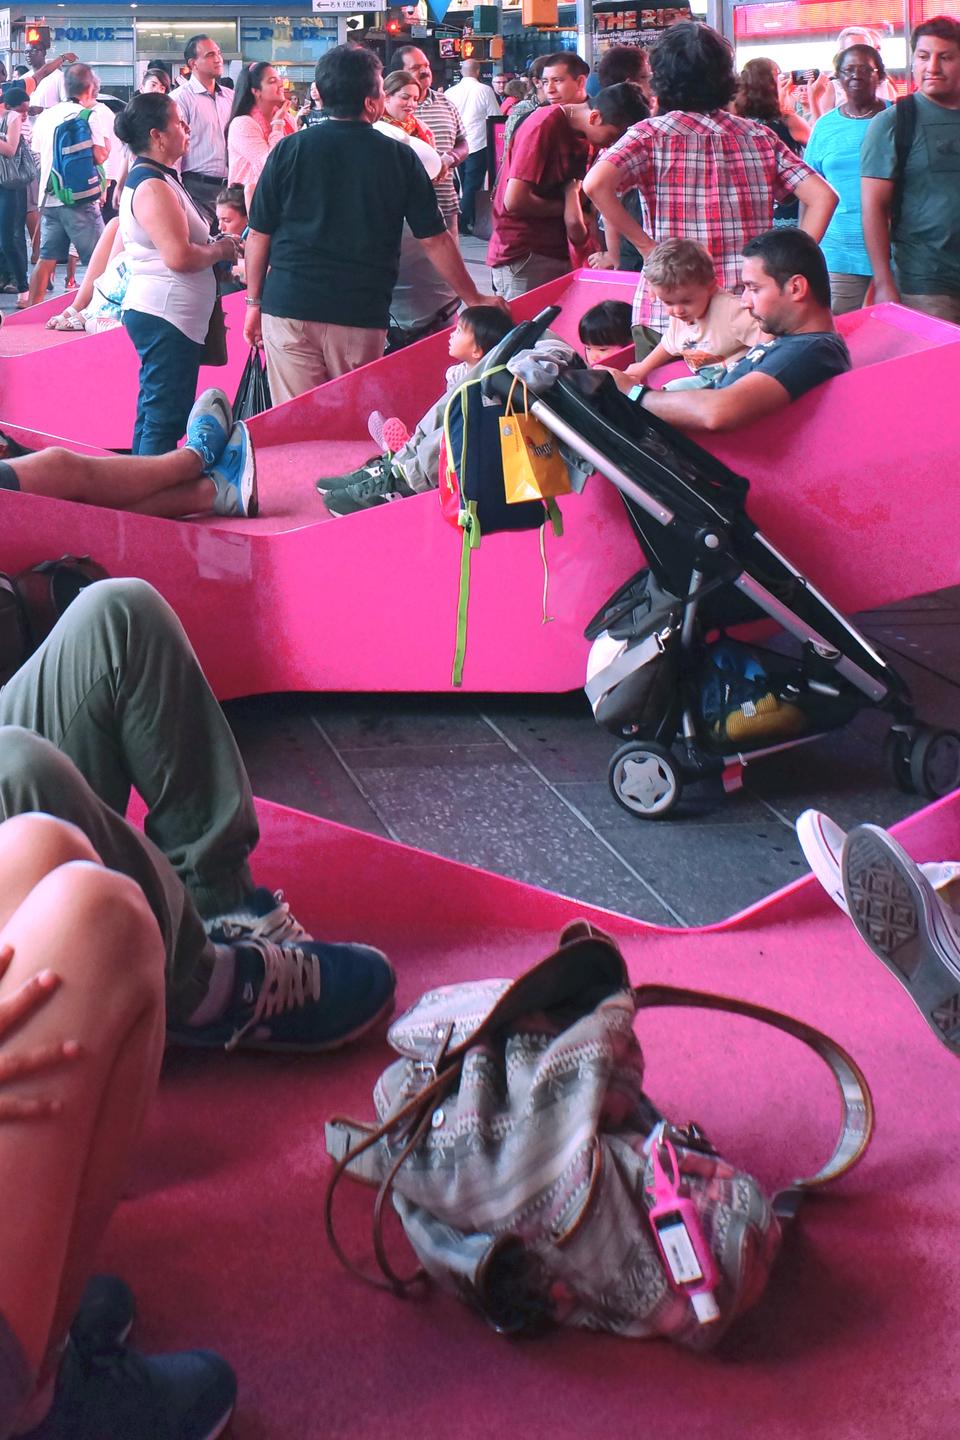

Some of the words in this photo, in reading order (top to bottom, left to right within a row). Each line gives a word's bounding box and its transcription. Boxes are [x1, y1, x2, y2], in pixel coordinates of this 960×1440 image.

[342, 0, 356, 8] KEEP
[356, 0, 376, 8] MOVING
[596, 11, 637, 30] THE
[54, 27, 115, 41] POLICE
